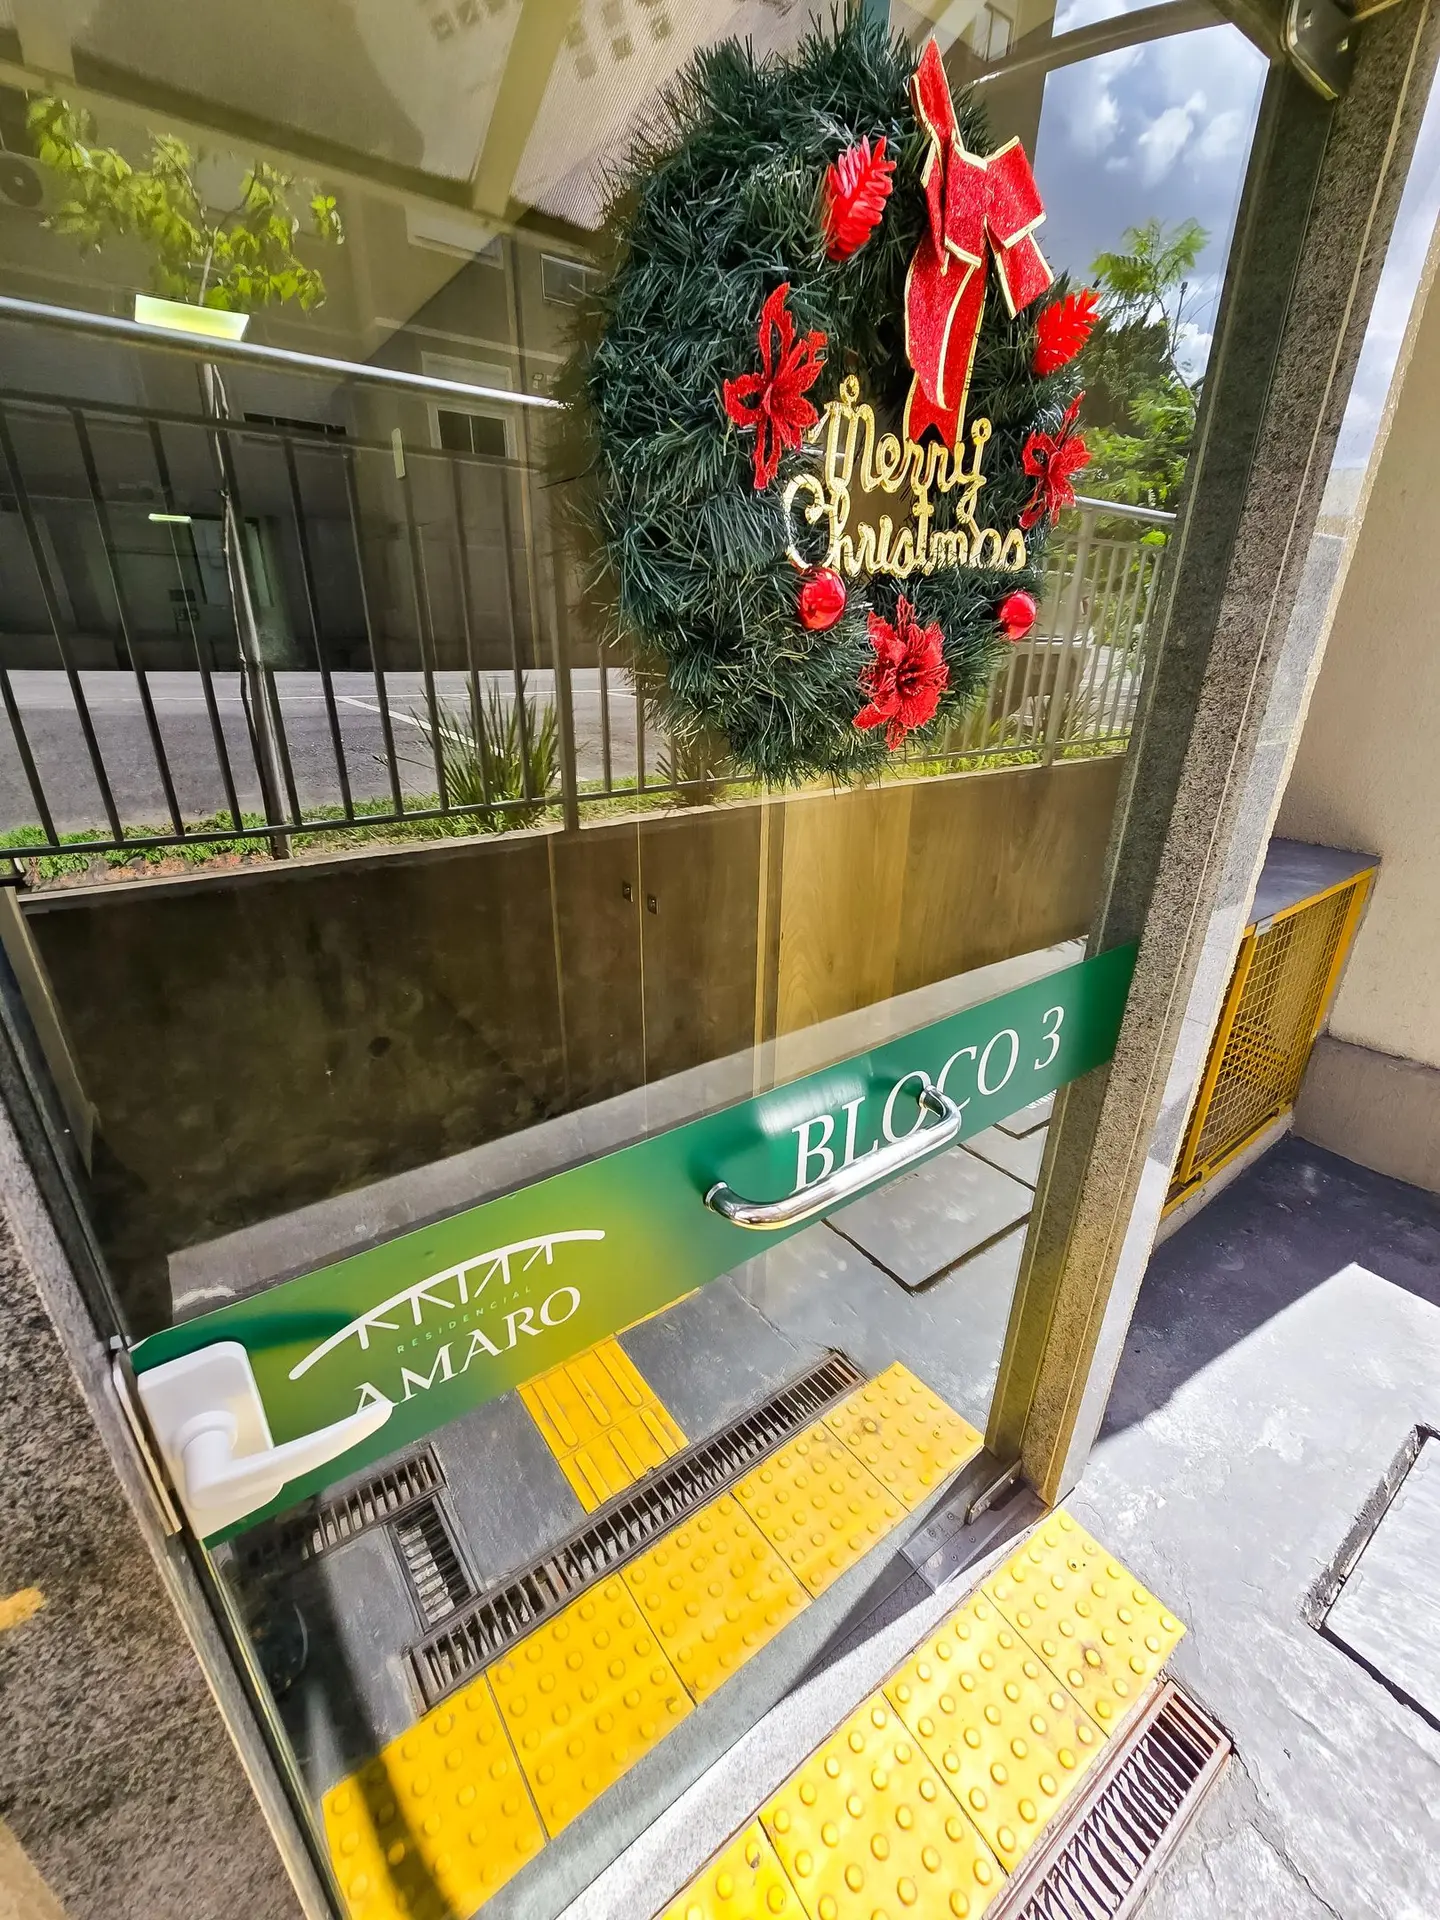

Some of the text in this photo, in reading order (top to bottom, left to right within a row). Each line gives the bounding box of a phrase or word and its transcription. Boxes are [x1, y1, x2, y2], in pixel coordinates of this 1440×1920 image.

[802, 399, 992, 524] Merry
[783, 473, 1027, 579] Christmas
[791, 1005, 1065, 1194] BLOCO 3
[353, 1286, 582, 1415] AMARO
[397, 1286, 532, 1354] RESIDENCIAL
